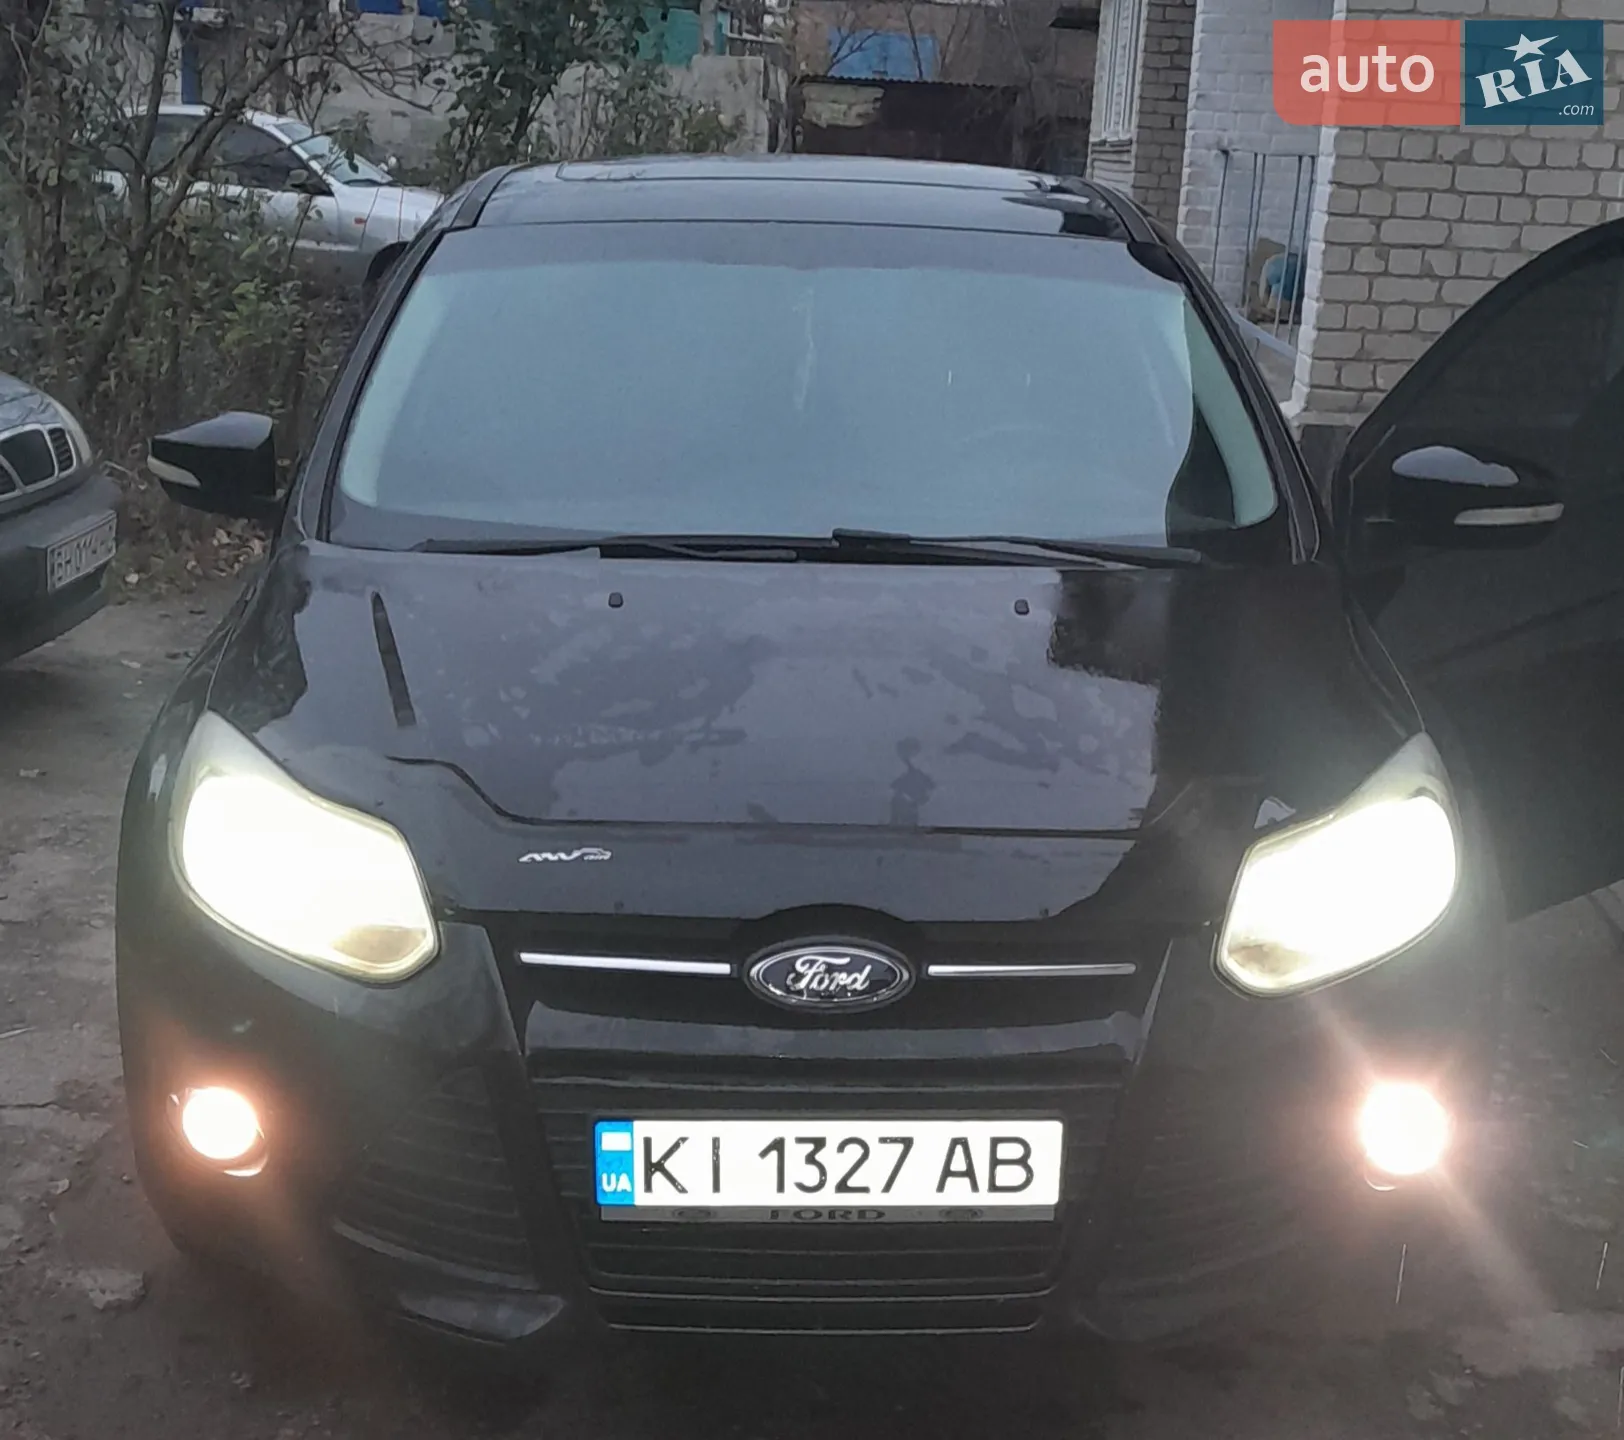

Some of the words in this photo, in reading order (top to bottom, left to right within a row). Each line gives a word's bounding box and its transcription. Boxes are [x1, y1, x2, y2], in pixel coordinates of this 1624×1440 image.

[786, 956, 872, 992] Ford
[643, 1136, 720, 1194] KI
[758, 1136, 914, 1194] 1327
[936, 1136, 1034, 1194] AB
[602, 1172, 632, 1193] UA
[769, 1208, 885, 1221] FORD
